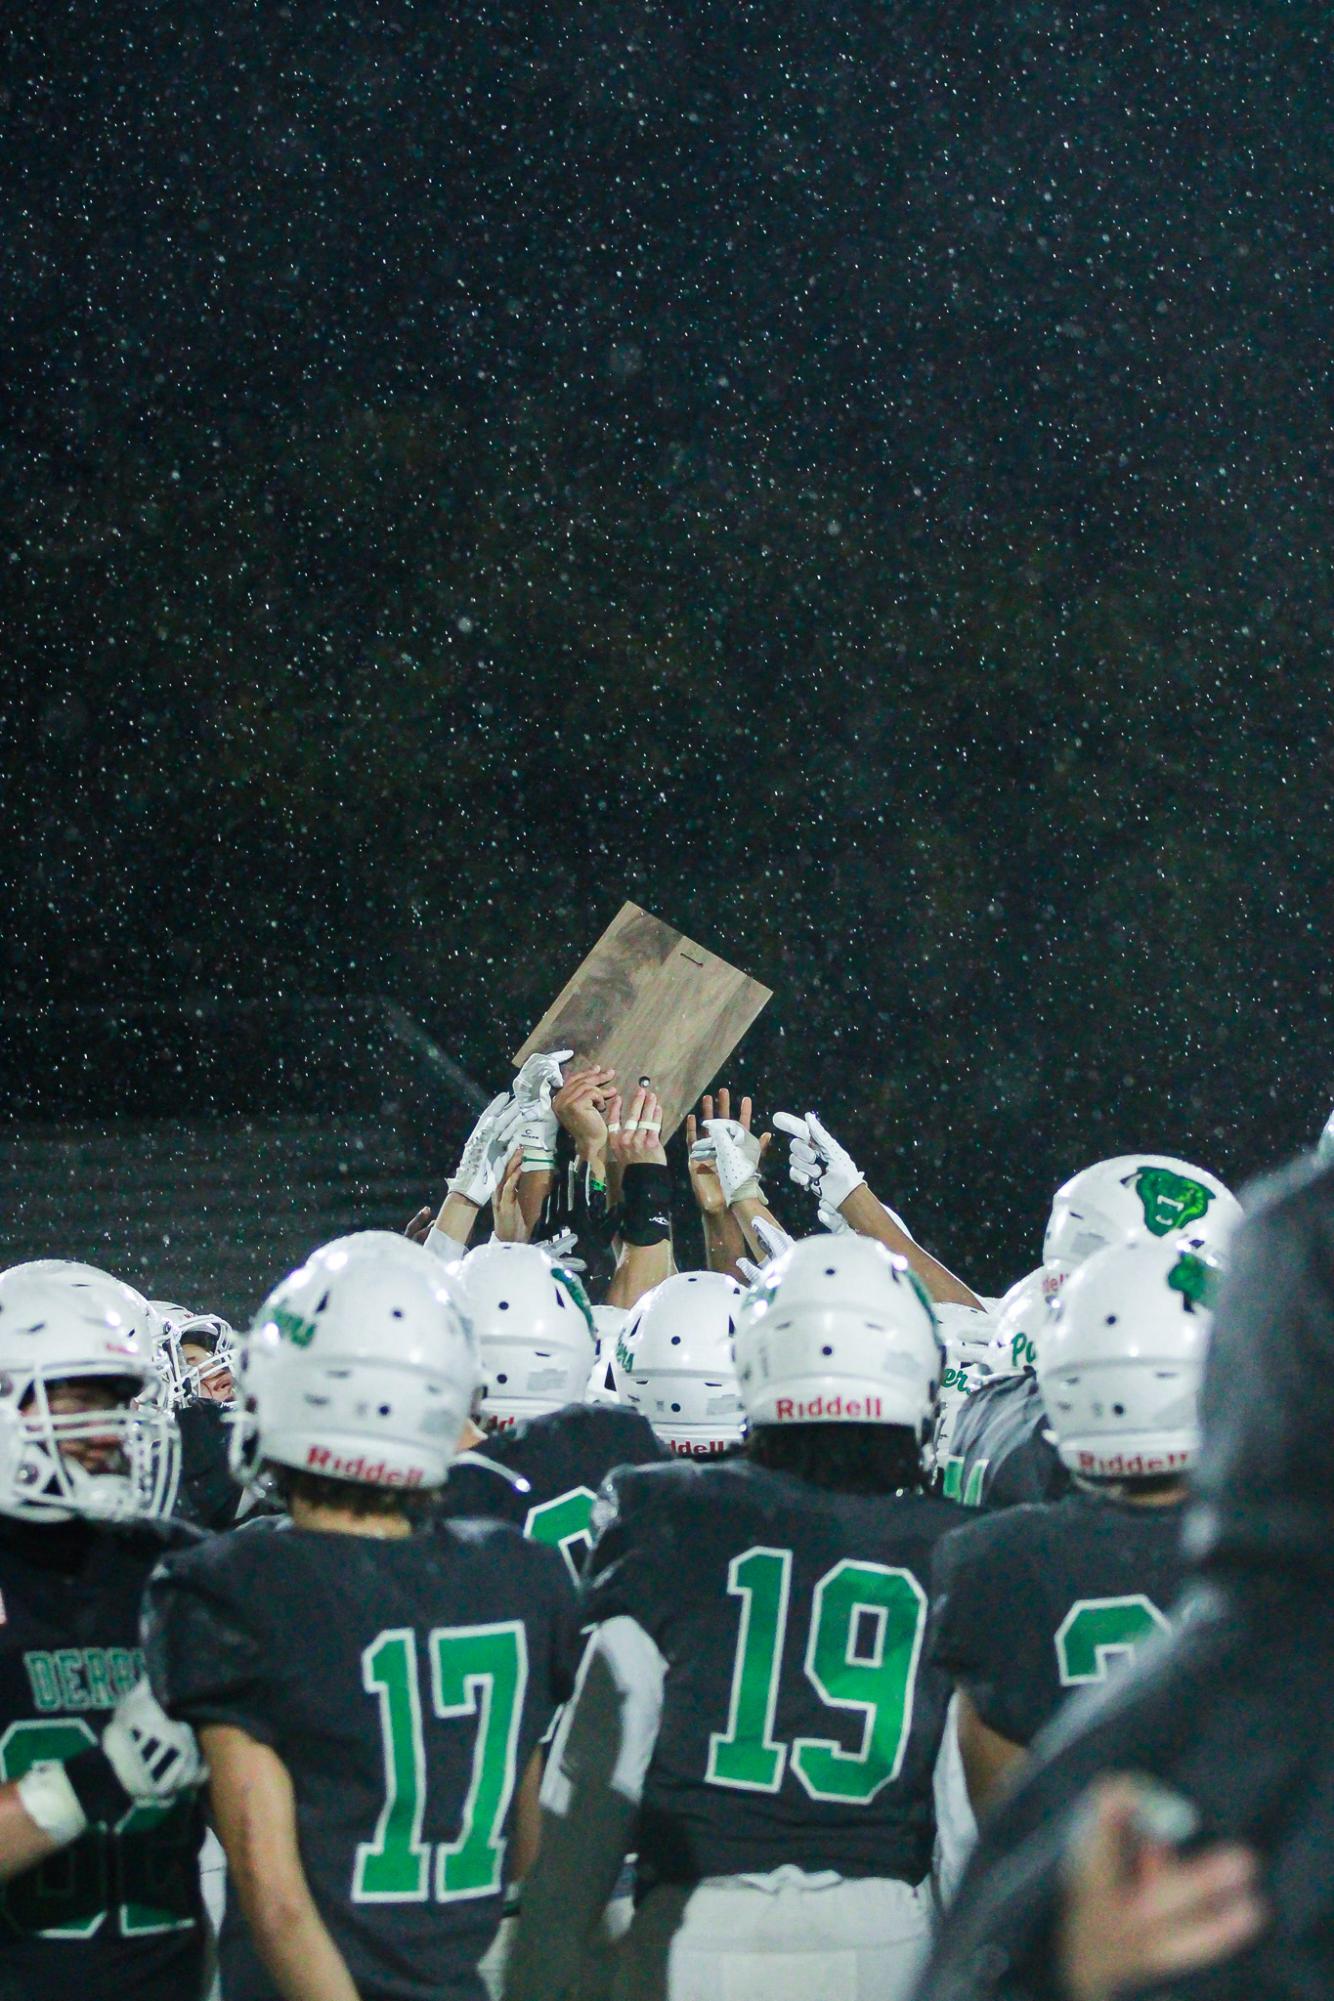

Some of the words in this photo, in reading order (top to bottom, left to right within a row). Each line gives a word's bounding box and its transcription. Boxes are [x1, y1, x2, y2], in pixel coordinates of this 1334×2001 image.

[776, 1395, 883, 1422] Riddell
[307, 1444, 425, 1486] Riddell
[1078, 1450, 1188, 1473] Riddell
[705, 1546, 927, 1804] 19
[352, 1620, 528, 1903] 17
